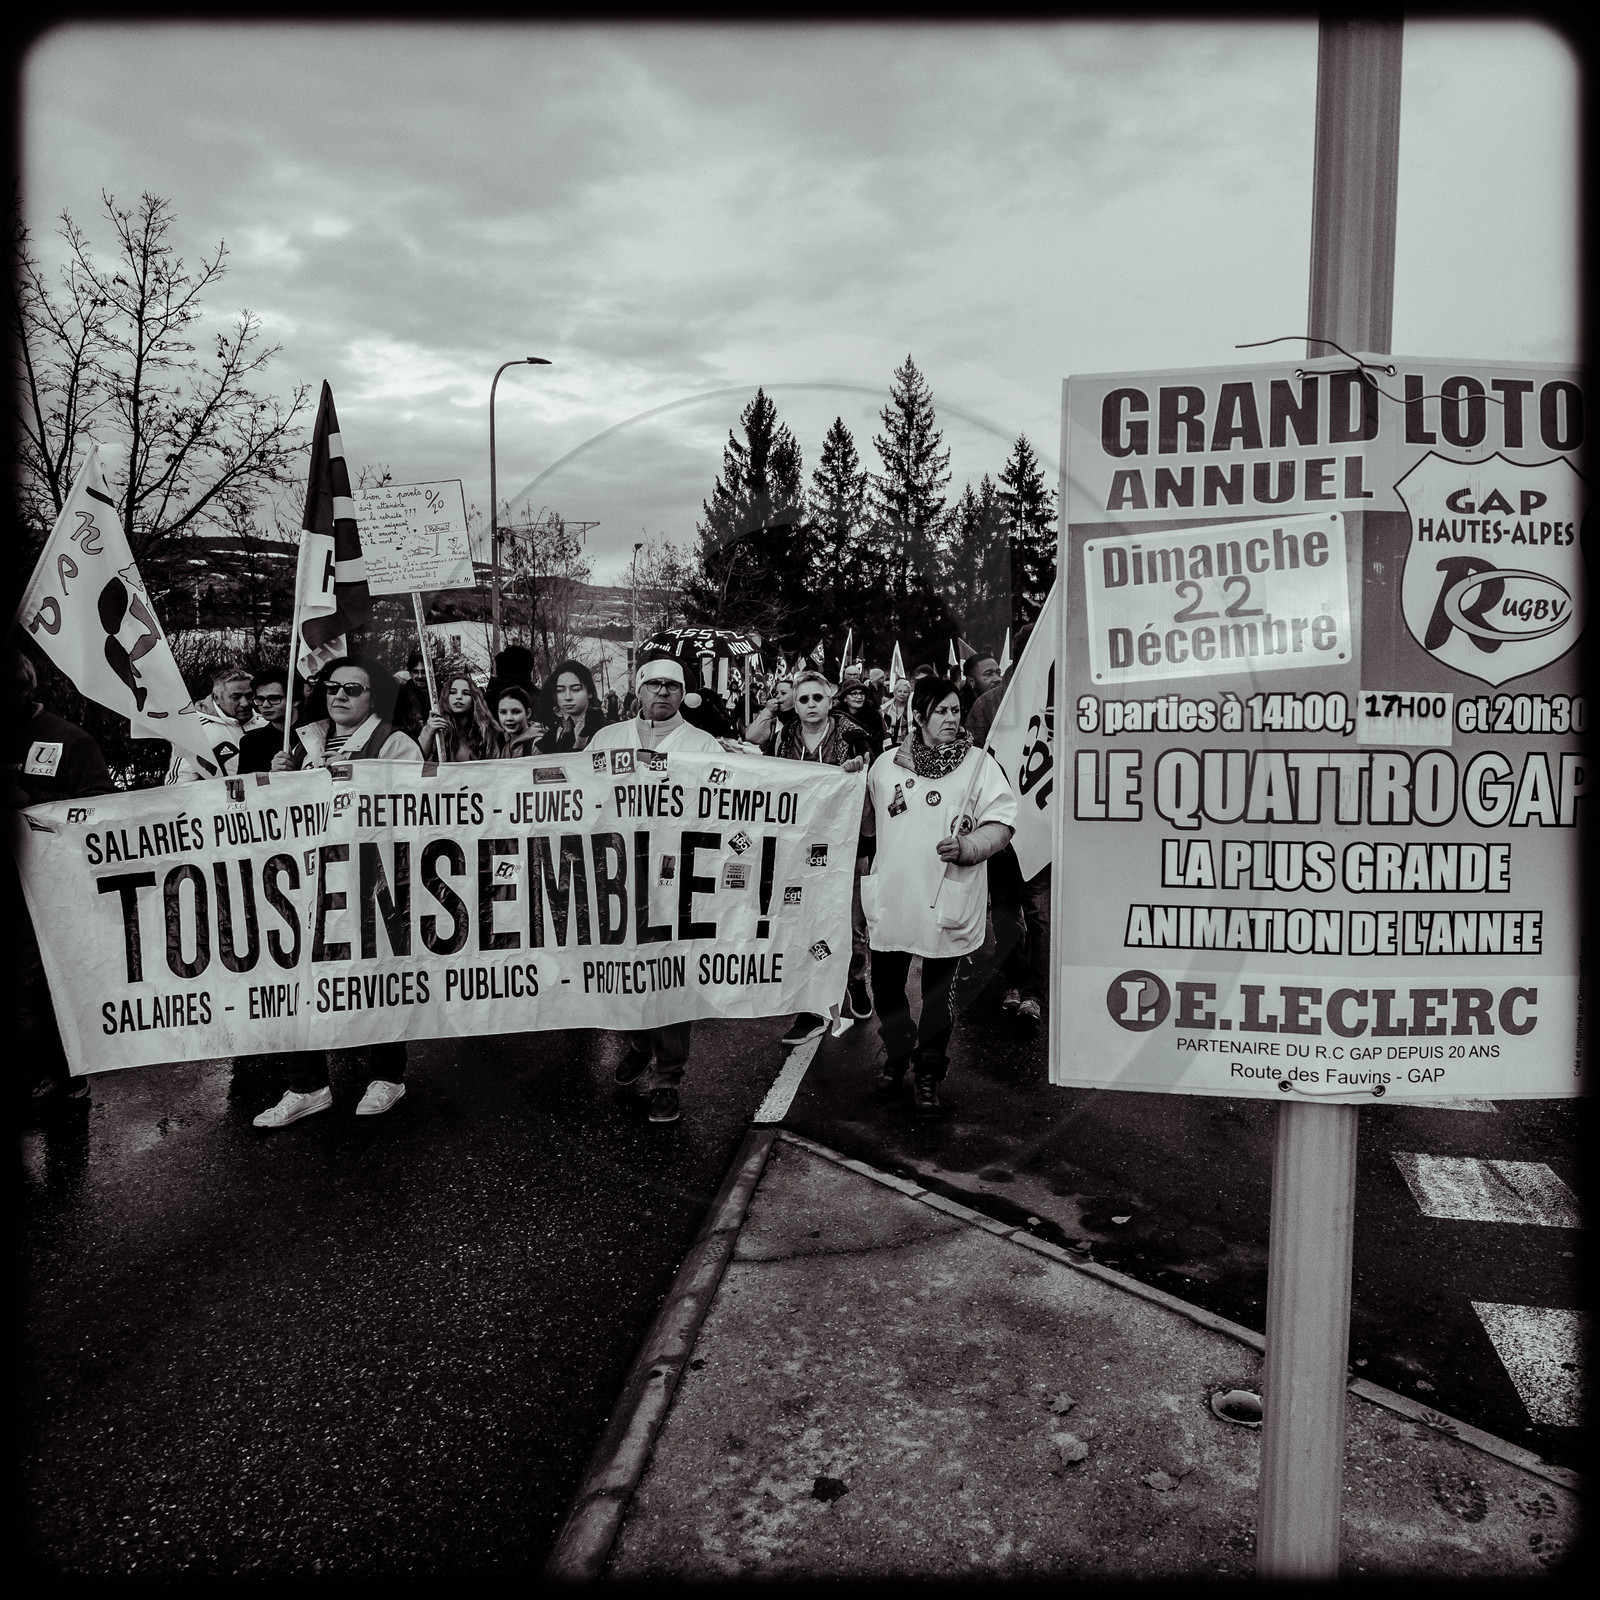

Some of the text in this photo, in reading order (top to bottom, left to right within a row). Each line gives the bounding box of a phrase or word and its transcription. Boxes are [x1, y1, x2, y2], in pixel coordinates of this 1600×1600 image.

[1100, 372, 1585, 458] GRAND LOTO
[1105, 455, 1374, 511] ANNUEL
[1445, 488, 1547, 516] GAP
[1417, 519, 1575, 546] HAUTES-ALPES
[1102, 528, 1330, 589] Dimanche
[1173, 575, 1265, 624] 22
[1108, 612, 1338, 670] Décembre
[1077, 694, 1099, 733] 3
[1103, 693, 1217, 736] parties
[1220, 691, 1245, 733] à
[1247, 692, 1355, 735] 14h00,
[1364, 695, 1446, 717] 17H00
[1455, 695, 1489, 732] et
[1489, 694, 1588, 735] 20h30
[593, 756, 607, 769] cgt
[614, 751, 631, 769] FO
[650, 757, 668, 771] cgt
[1073, 748, 1592, 830] LE QUATTRO GAP
[85, 811, 204, 865] SALARIÉS
[357, 786, 485, 827] RETRAITÉS
[509, 788, 584, 824] JEUNES
[614, 777, 685, 818] PRIVÉS
[697, 786, 799, 825] D'EMPLOI
[810, 851, 829, 866] cgt
[1161, 838, 1511, 893] LA PLUS GRANDE
[96, 831, 778, 984] TOUS ENSEMBLE !
[784, 887, 802, 902] cgt
[814, 943, 829, 961] cgt
[1124, 904, 1543, 956] ANIMATION DE L'ANNEE
[101, 989, 212, 1036] SALAIRES
[316, 970, 430, 1014] SERVICES
[445, 964, 539, 1001] PUBLICS
[583, 954, 686, 996] PROTECTION
[698, 952, 784, 986] SOCIALE
[1175, 979, 1539, 1038] E.LECLERC
[1176, 1038, 1281, 1058] PARTENAIRE
[1285, 1044, 1310, 1058] DU
[1349, 1046, 1383, 1061] GAP
[1386, 1045, 1445, 1060] DEPUIS
[1448, 1045, 1466, 1059] 20
[1470, 1044, 1501, 1059] ANS
[1230, 1062, 1281, 1082] Route
[1287, 1065, 1320, 1084] des
[1325, 1067, 1392, 1085] Fauvins
[1407, 1067, 1446, 1084] GAP
